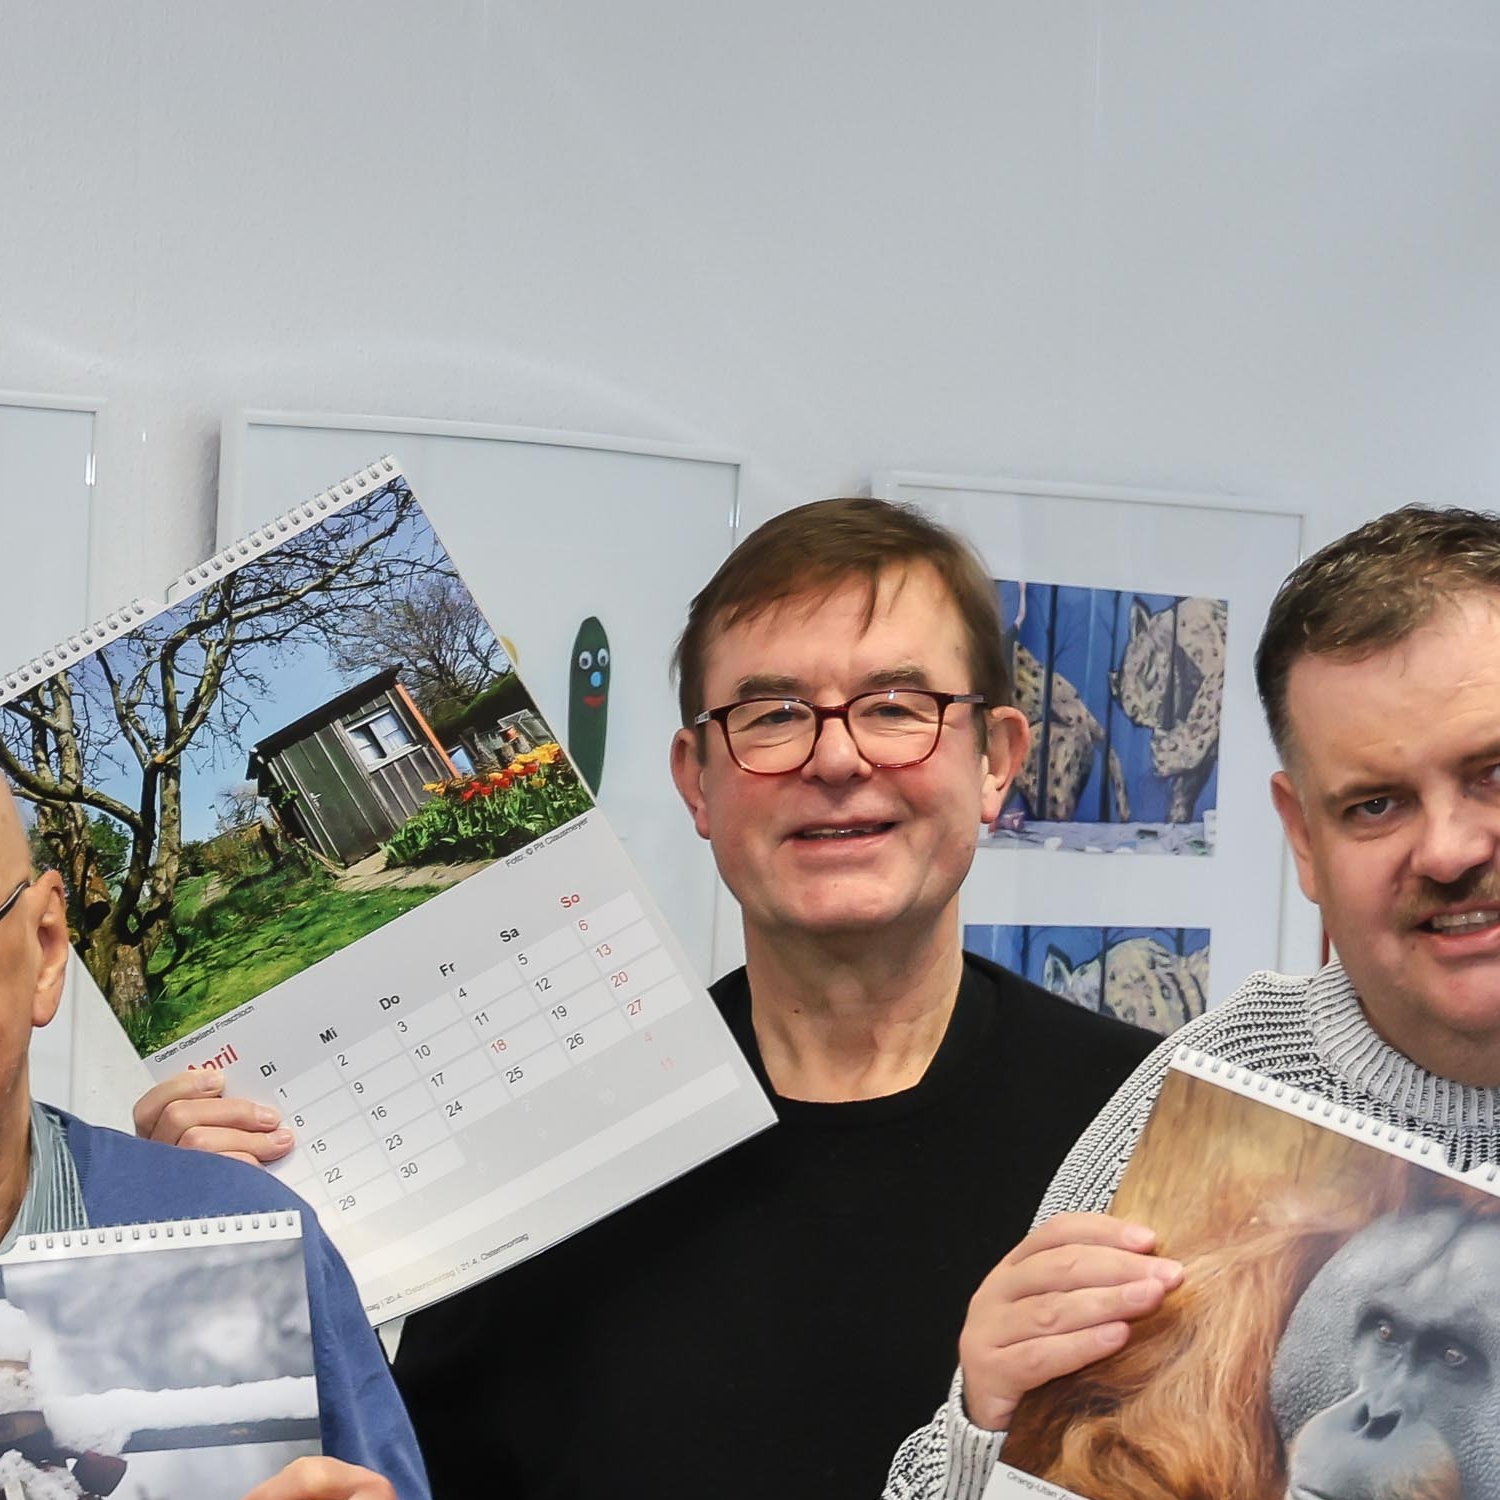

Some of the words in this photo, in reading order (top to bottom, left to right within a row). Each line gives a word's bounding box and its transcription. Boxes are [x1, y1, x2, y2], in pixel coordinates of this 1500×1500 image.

[155, 1046, 179, 1063] Garten
[260, 1065, 276, 1077] Di
[320, 1028, 337, 1043] Mi
[379, 996, 399, 1010] Do
[440, 963, 454, 976] Fr
[500, 929, 519, 942] Sa
[561, 895, 580, 908] So
[279, 1088, 287, 1098] 1
[337, 1055, 348, 1066] 2
[397, 1021, 407, 1032] 3
[459, 988, 467, 997] 4
[518, 953, 528, 965] 5
[579, 920, 588, 931] 6
[294, 1115, 304, 1127] 8
[354, 1082, 364, 1093] 9
[415, 1045, 430, 1059] 10
[475, 1012, 489, 1025] 11
[535, 978, 551, 992] 12
[596, 944, 611, 958] 13
[311, 1139, 326, 1154] 15
[371, 1106, 387, 1120] 16
[431, 1072, 444, 1087] 17
[491, 1039, 507, 1053] 18
[552, 1006, 567, 1019] 19
[611, 971, 628, 988] 20
[325, 1168, 342, 1183] 22
[386, 1134, 402, 1150] 23
[446, 1101, 462, 1117] 24
[506, 1067, 523, 1083] 25
[566, 1033, 584, 1050] 26
[627, 999, 641, 1016] 27
[339, 1195, 356, 1211] 29
[400, 1162, 418, 1178] 30
